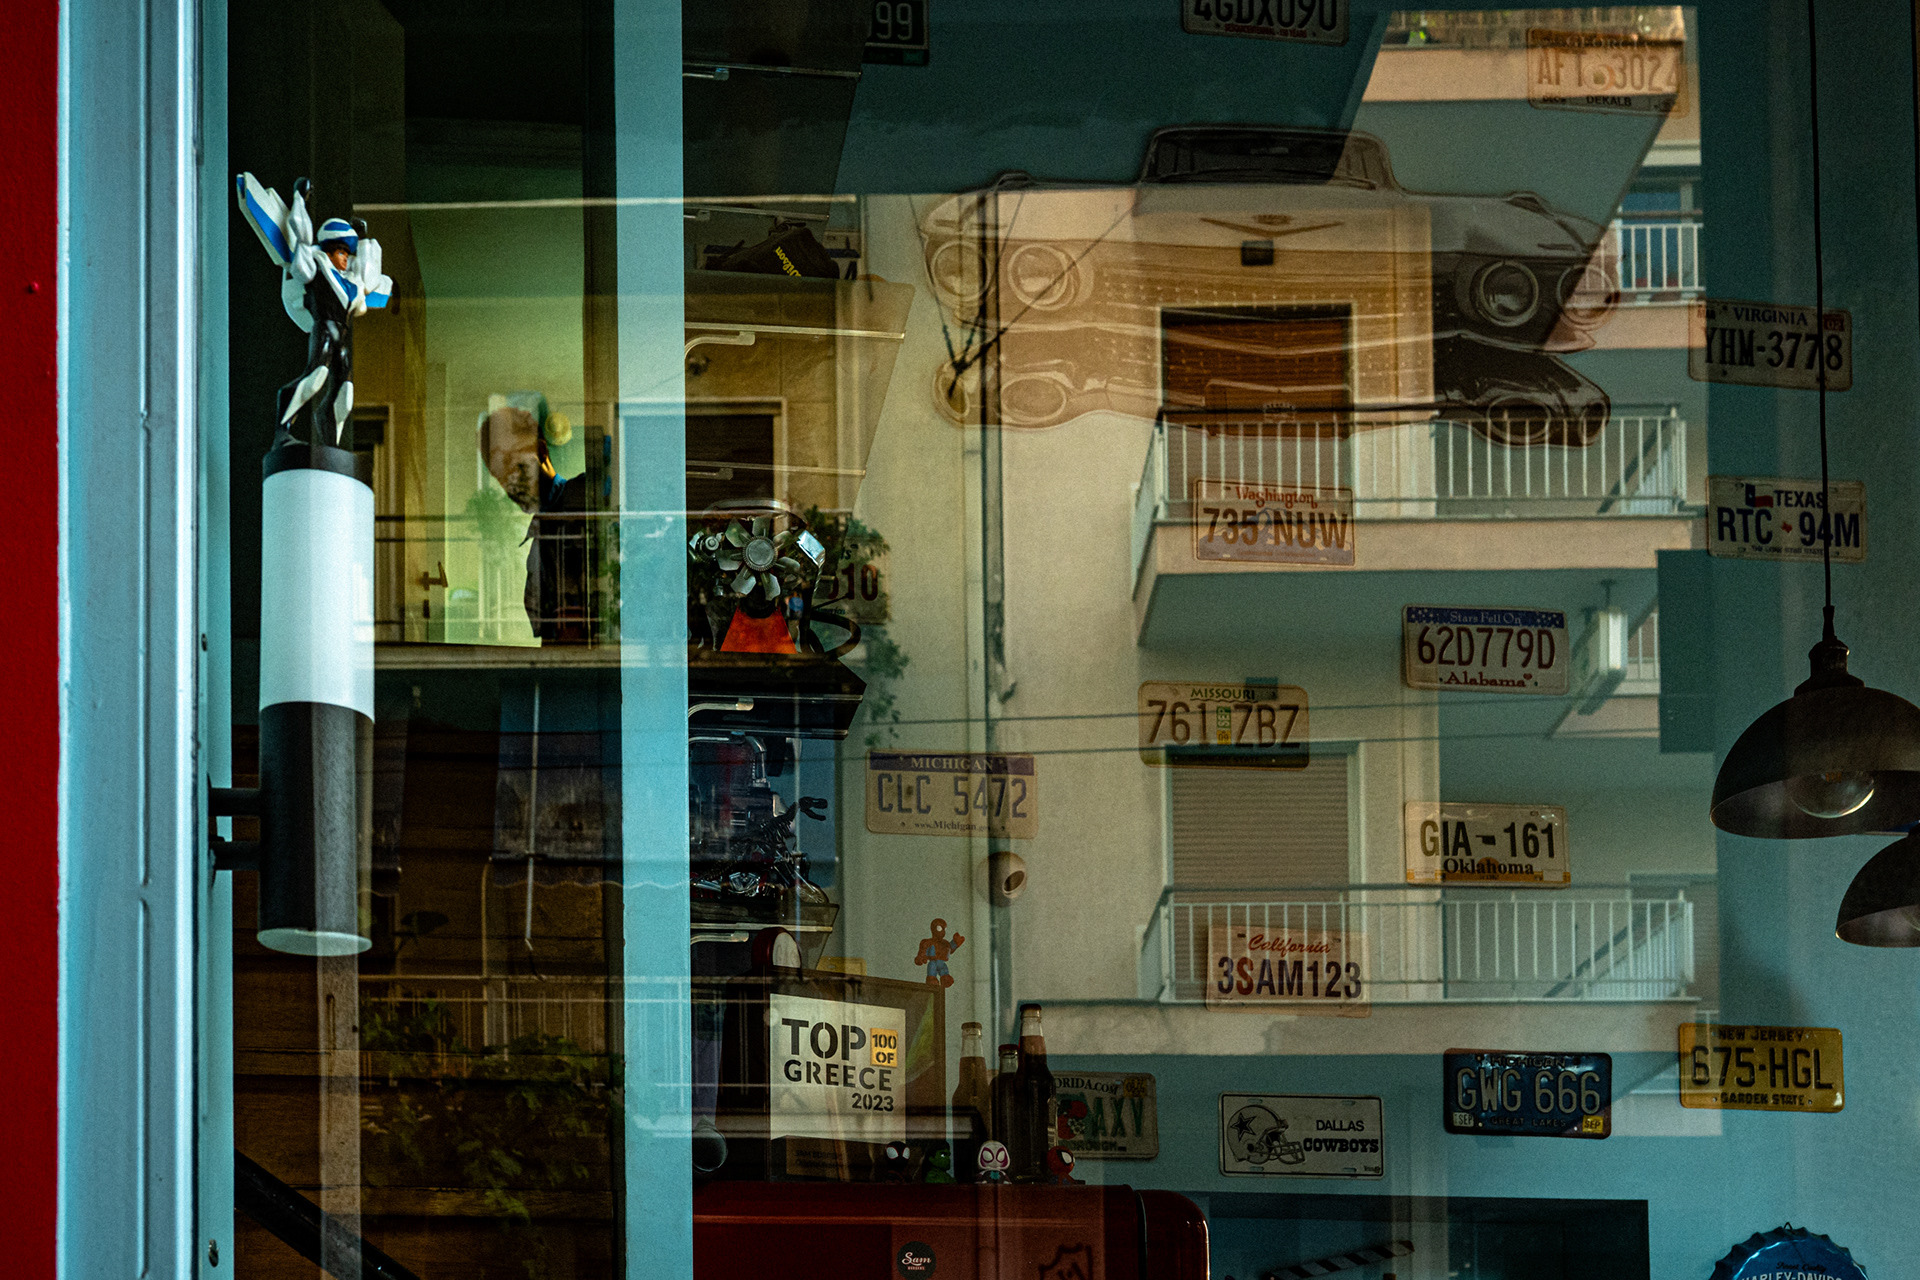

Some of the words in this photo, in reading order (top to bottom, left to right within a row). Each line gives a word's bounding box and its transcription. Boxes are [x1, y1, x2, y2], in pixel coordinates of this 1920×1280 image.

[1586, 95, 1632, 107] DEKALB
[1733, 306, 1808, 326] VIRGINIA
[1236, 486, 1318, 509] Washington
[1773, 489, 1824, 509] TEXAS
[1203, 507, 1259, 546] 735
[1273, 510, 1348, 549] NUW
[1717, 506, 1773, 545] RTC
[1799, 511, 1860, 548] 94M
[1450, 611, 1479, 624] Stars
[1480, 612, 1501, 624] Fell
[1503, 612, 1522, 625] On
[1418, 625, 1556, 670] 62D779D
[1445, 671, 1527, 688] Alabama
[1190, 687, 1256, 700] MISSOURI
[1147, 700, 1211, 747] 761
[1217, 707, 1231, 728] SEP
[911, 756, 994, 771] MICHIGAN
[877, 773, 932, 815] CLC
[953, 776, 1028, 819] 5472
[1443, 857, 1534, 875] Oklahoma
[1248, 933, 1332, 958] California
[1217, 956, 1362, 999] 3SAM123
[781, 1017, 867, 1061] TOP
[872, 1033, 897, 1050] 100
[1717, 1029, 1745, 1041] NEW
[1751, 1029, 1805, 1042] JERSEY
[875, 1051, 895, 1064] OF
[1489, 1055, 1566, 1068] MICHIGAN
[783, 1059, 892, 1092] GREECE
[1055, 1077, 1119, 1095] ORIDA.COM
[1457, 1067, 1522, 1112] GWG
[1534, 1069, 1601, 1115] 666
[851, 1092, 894, 1112] 2023
[1720, 1092, 1768, 1105] GARDEN
[1771, 1093, 1805, 1106] STATE
[1316, 1119, 1365, 1132] DALLAS
[1458, 1113, 1473, 1125] SEP
[1491, 1116, 1525, 1126] GREAT
[1532, 1117, 1566, 1127] LAKES
[1303, 1137, 1379, 1154] COWBOYS
[901, 1251, 932, 1267] Sam
